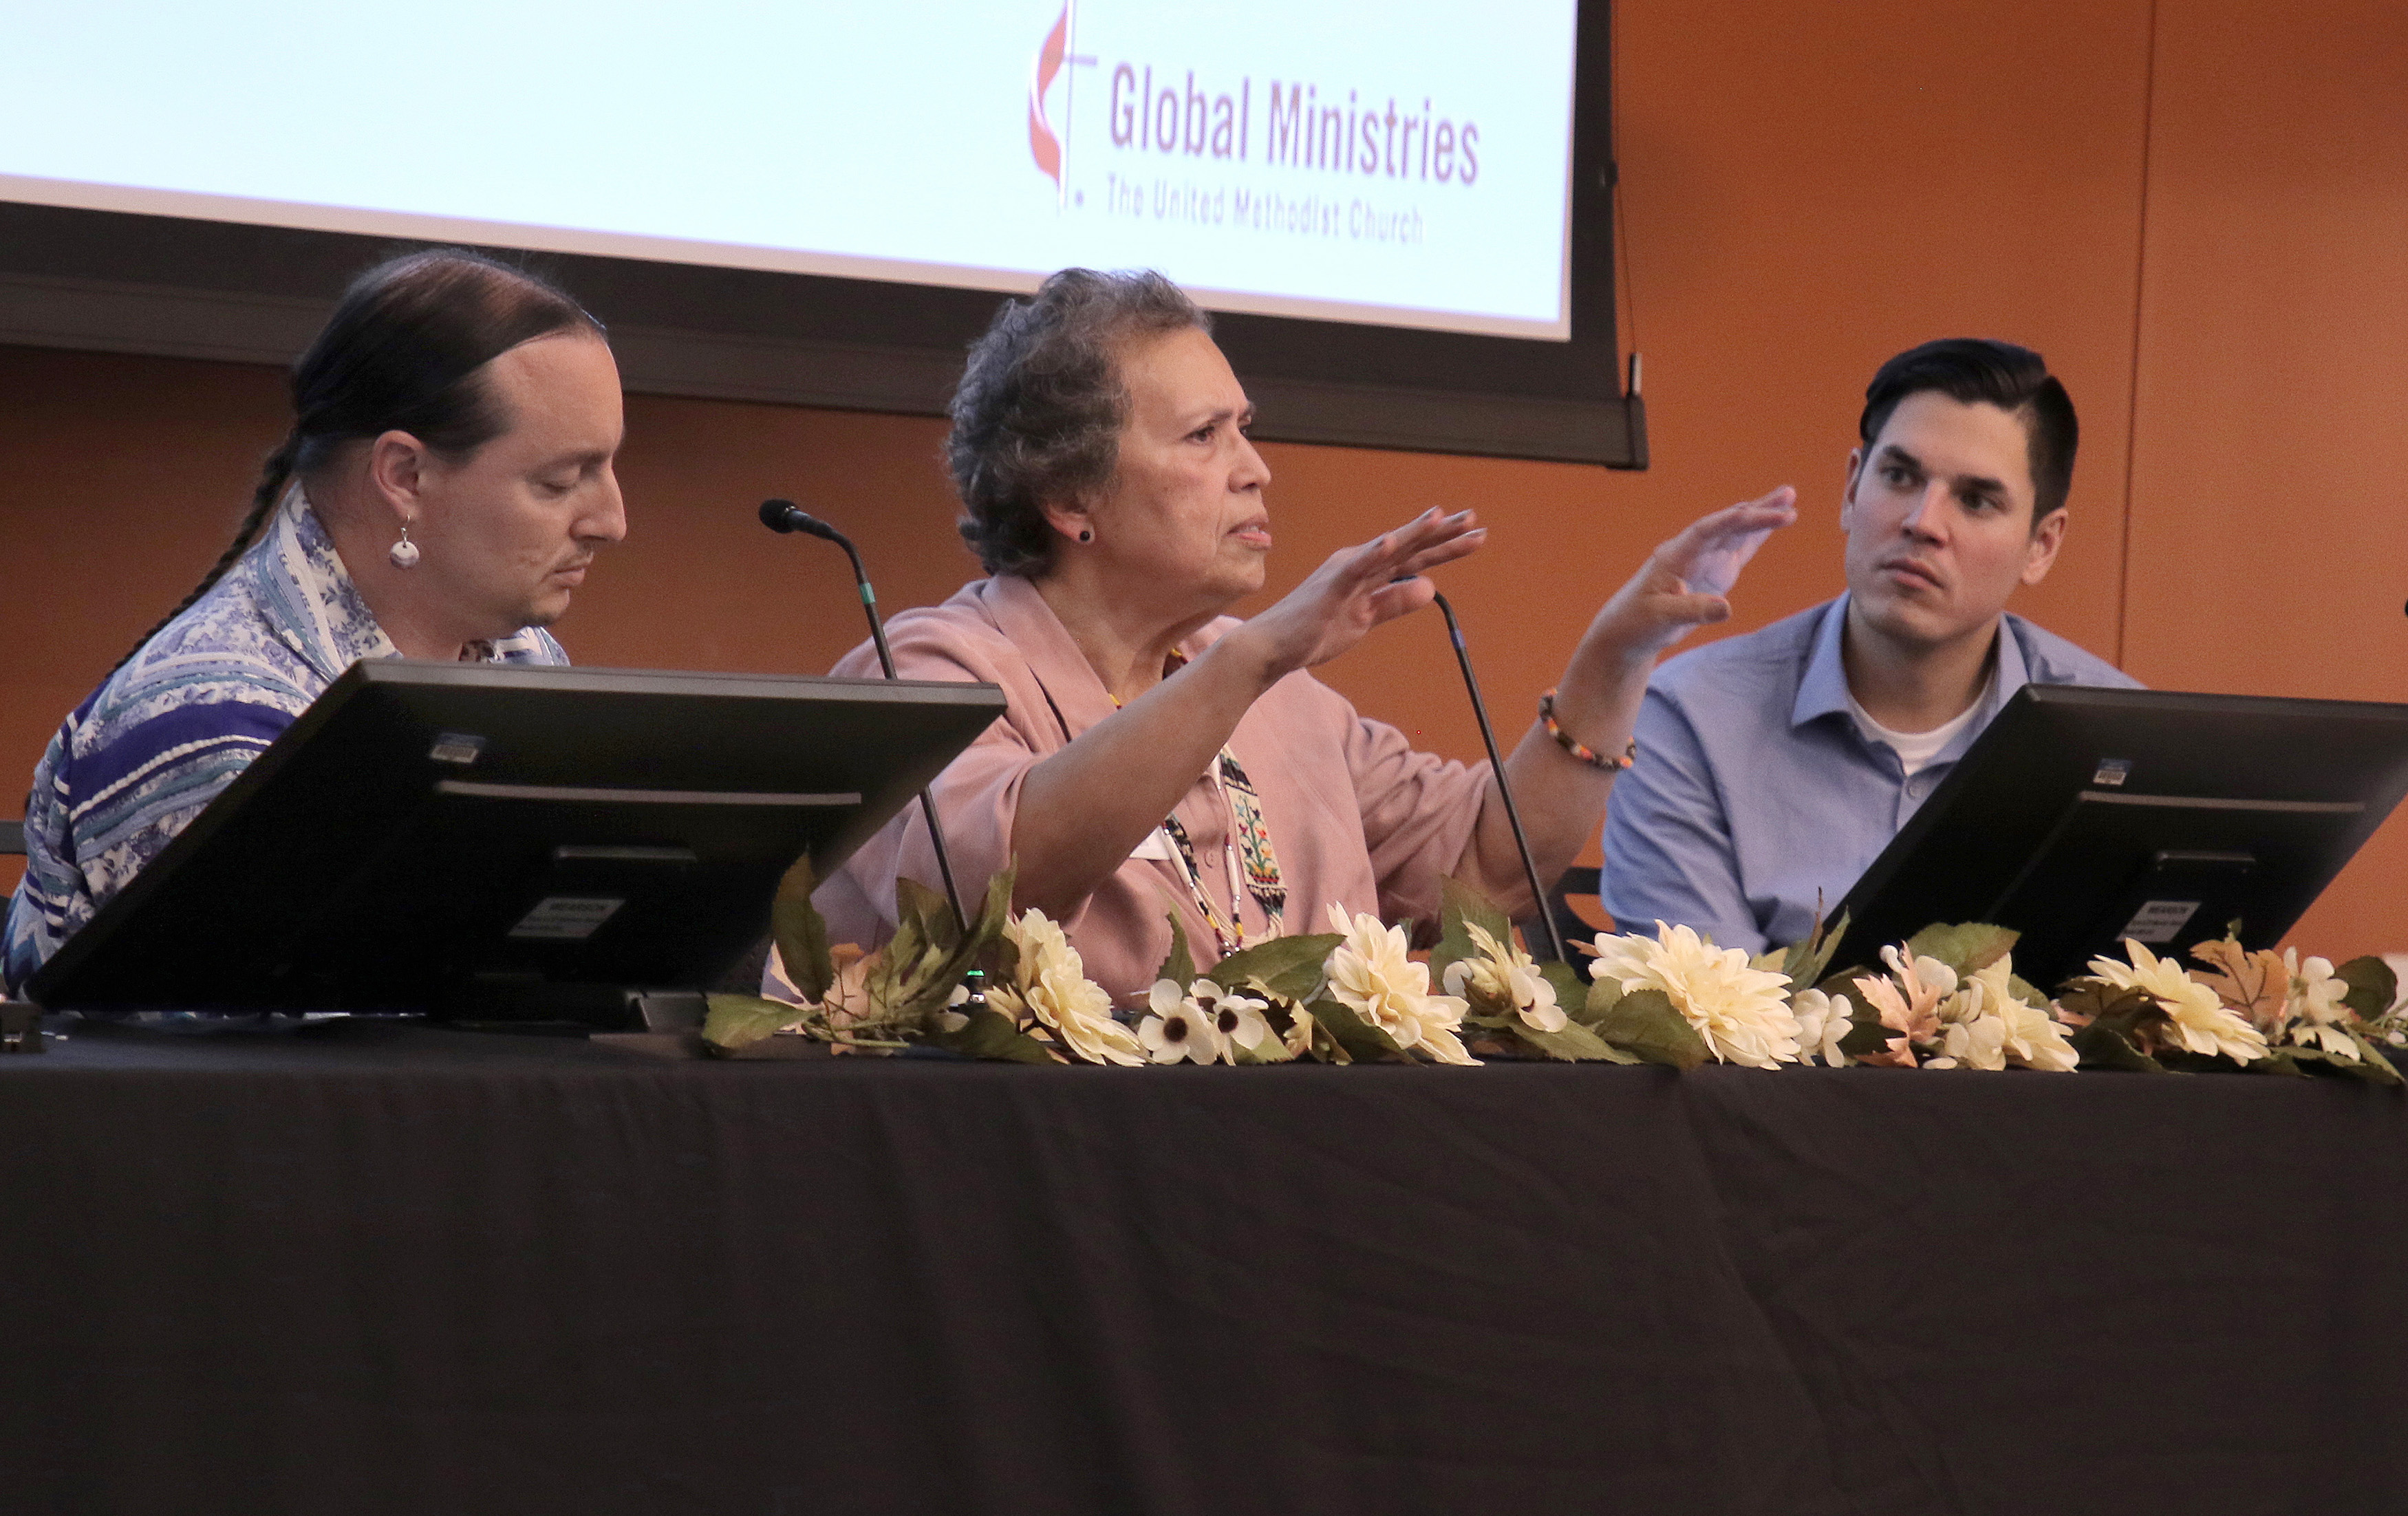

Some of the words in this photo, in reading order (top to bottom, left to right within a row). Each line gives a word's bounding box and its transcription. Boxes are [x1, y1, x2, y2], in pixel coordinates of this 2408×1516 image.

[1110, 61, 1250, 162] Global
[1267, 79, 1480, 186] Ministries
[1108, 171, 1144, 218] The
[1153, 178, 1225, 226] United
[1233, 186, 1341, 237] Methodist
[1348, 197, 1424, 245] Church
